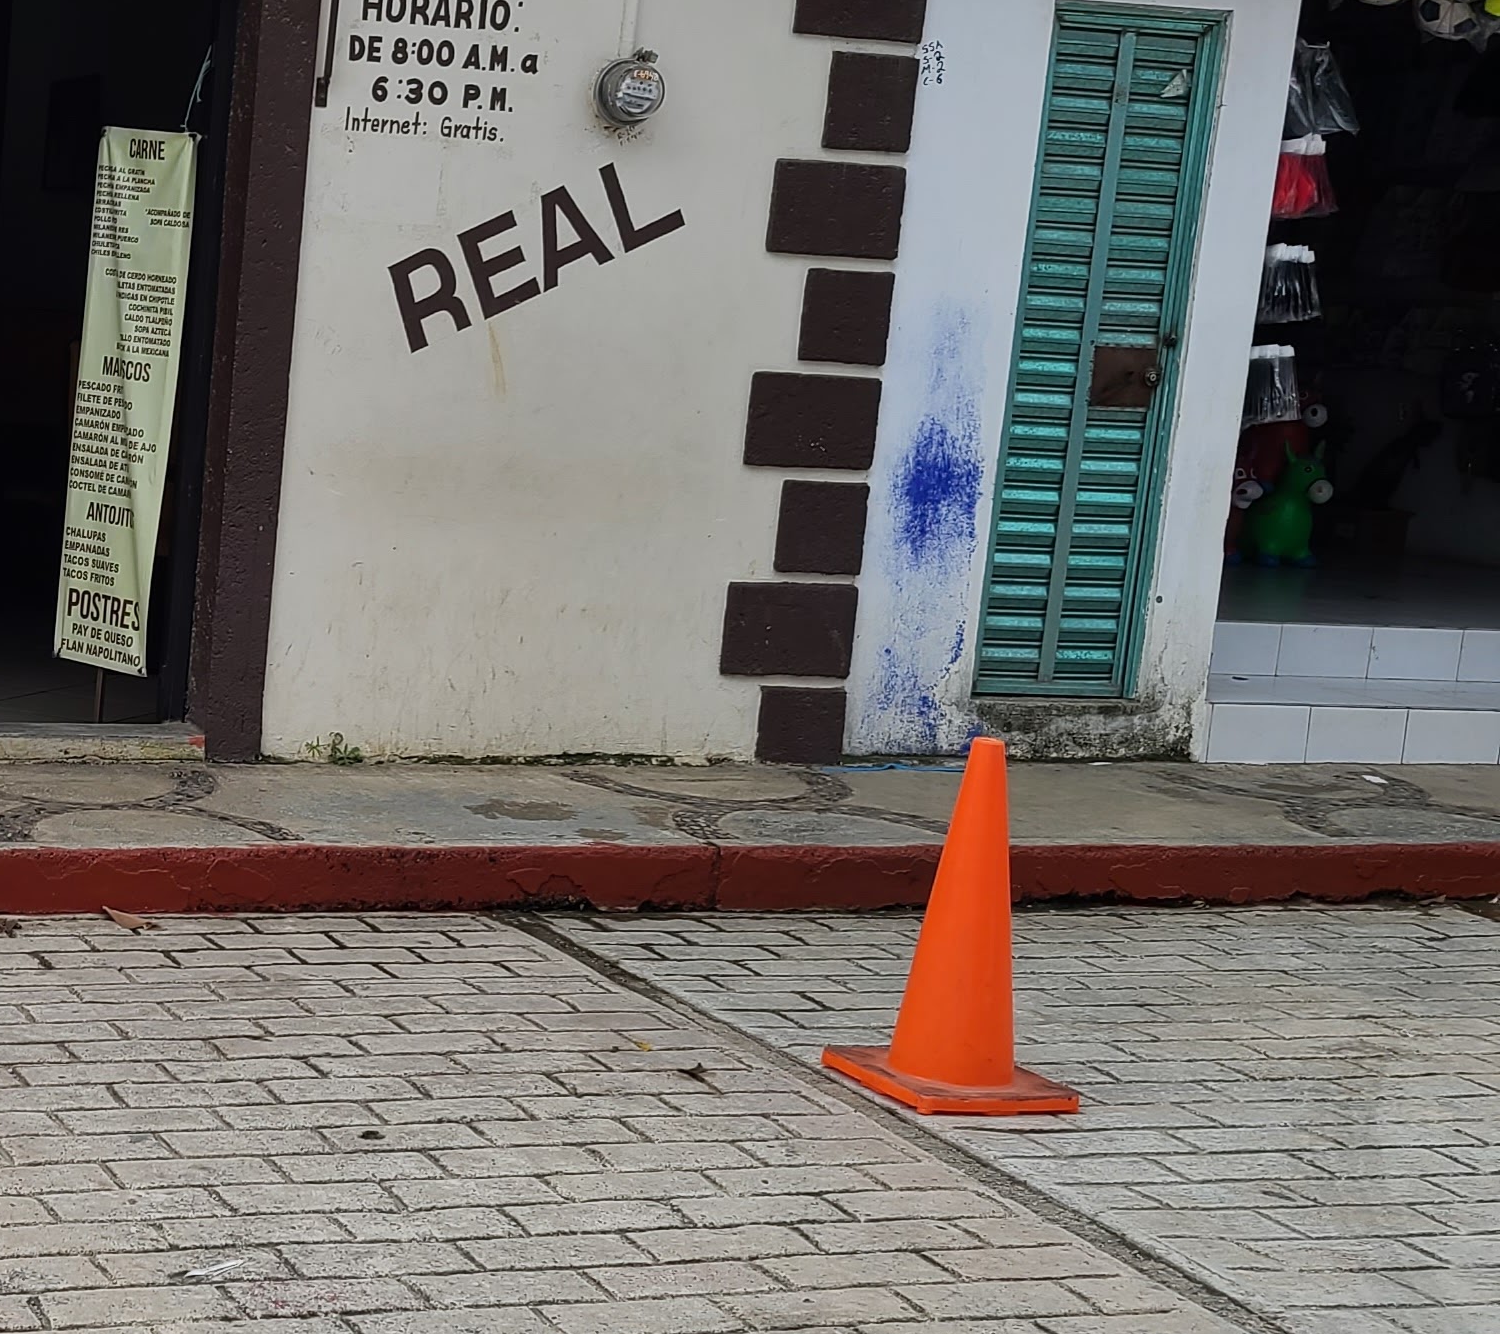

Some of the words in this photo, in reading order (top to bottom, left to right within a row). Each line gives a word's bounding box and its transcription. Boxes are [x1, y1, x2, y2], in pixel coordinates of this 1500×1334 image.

[348, 34, 384, 63] DE
[390, 38, 456, 67] 8:00
[461, 43, 515, 73] A.M.
[522, 51, 540, 75] a
[371, 75, 449, 106] 6:30
[344, 106, 428, 136] Internet:
[440, 116, 505, 143] Gratis.
[129, 138, 166, 161] CARNE
[387, 161, 686, 355] REAL
[124, 313, 144, 323] CALDO
[78, 379, 112, 394] PESCADO
[76, 391, 102, 405] FILETE
[102, 395, 114, 407] DE
[75, 404, 121, 420] EMPANIZADO
[74, 418, 110, 432] CAMARÓN
[72, 442, 109, 457] ENSALADA
[110, 448, 120, 459] DE
[73, 430, 109, 444] CAMARÓN
[109, 435, 120, 446] AL
[128, 440, 140, 451] DE
[140, 442, 158, 454] AJO
[71, 454, 107, 469] ENSALADA
[108, 460, 119, 471] DE
[69, 479, 97, 492] COCTEL
[97, 484, 107, 495] DE
[105, 473, 116, 483] DE
[65, 526, 107, 543] CHALUPAS
[64, 540, 110, 558] EMPANADAS
[63, 553, 89, 567] TACOS
[91, 559, 120, 574] SUAVES
[62, 567, 88, 581] TACOS
[89, 572, 115, 587] FRITOS
[66, 587, 140, 632] POSTRES
[72, 622, 89, 637] PAY
[90, 627, 102, 641] DE
[104, 630, 133, 648] QUESO
[60, 637, 84, 653] FLAN
[85, 643, 141, 667] NAPOLITANO
